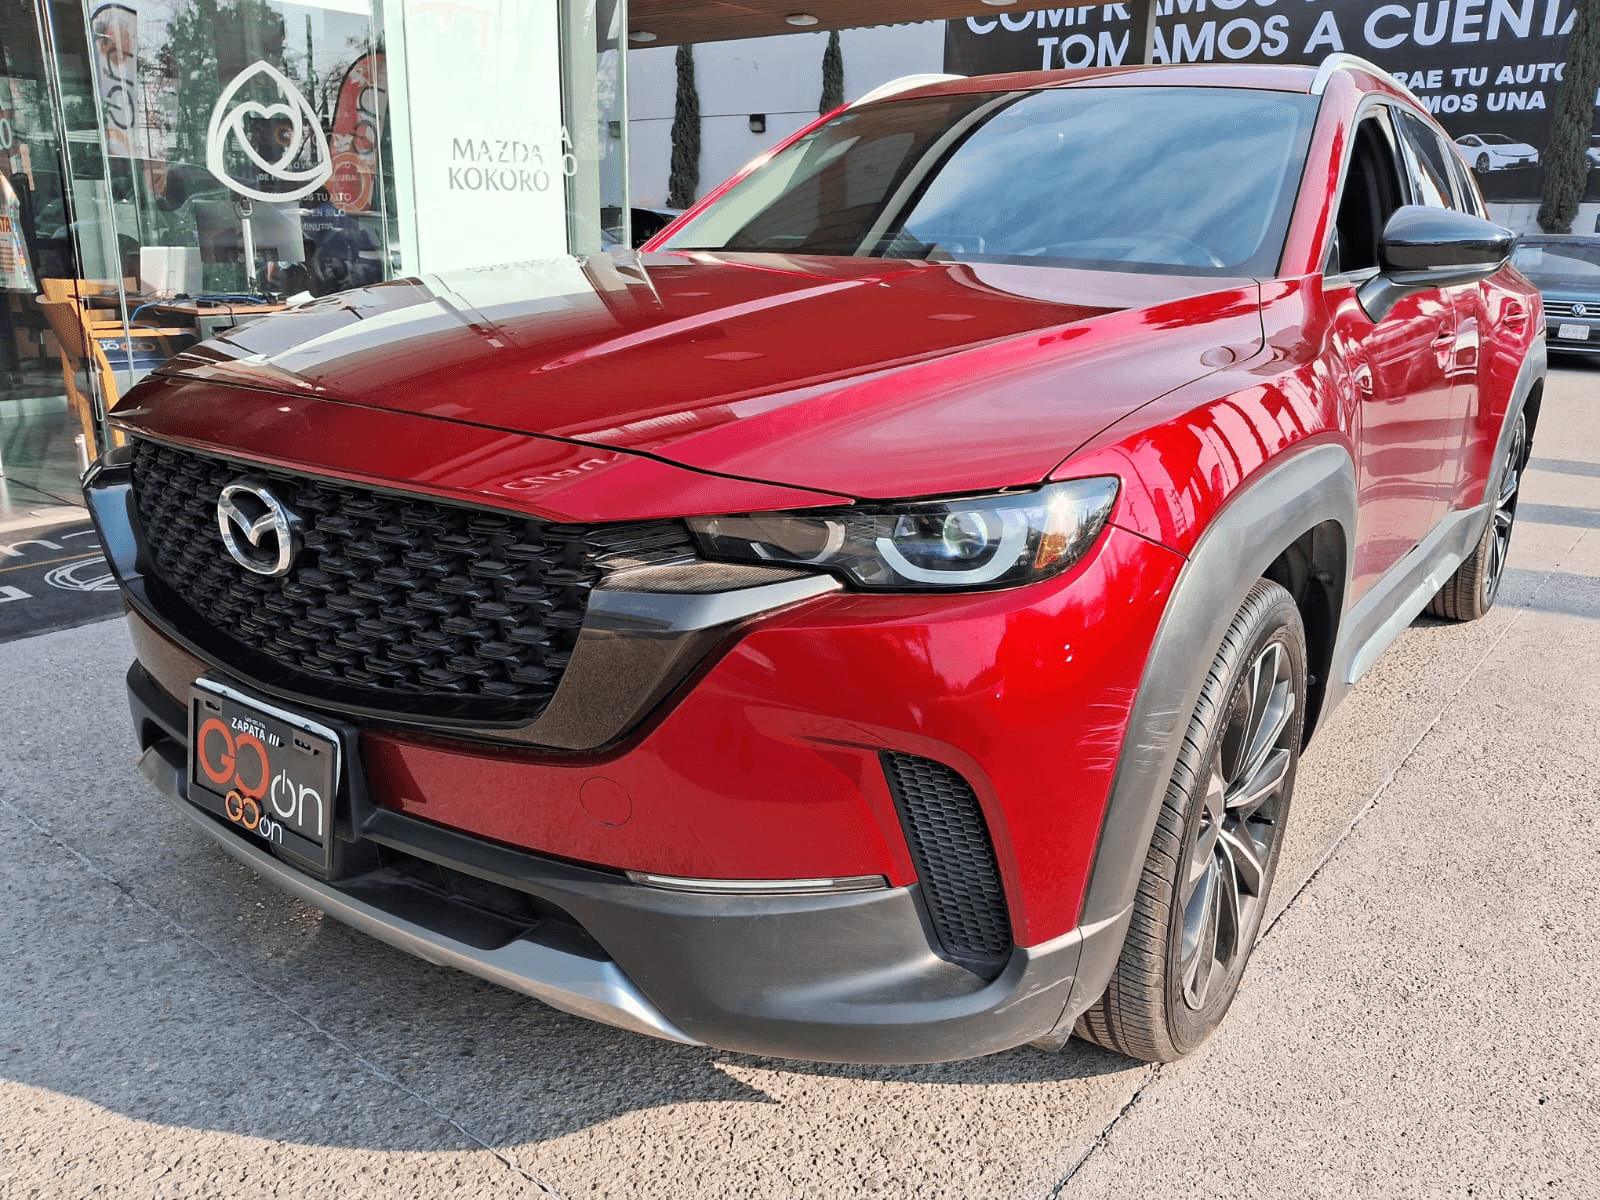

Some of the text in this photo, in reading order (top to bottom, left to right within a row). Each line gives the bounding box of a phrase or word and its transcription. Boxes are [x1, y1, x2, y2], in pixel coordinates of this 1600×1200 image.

[1302, 10, 1345, 55] A
[1390, 69, 1444, 90] RAE
[1451, 66, 1489, 87] TU
[1486, 91, 1546, 111] UNA
[452, 138, 543, 164] MAZDA
[448, 167, 550, 192] KOKORO
[231, 717, 266, 742] ZAPATA
